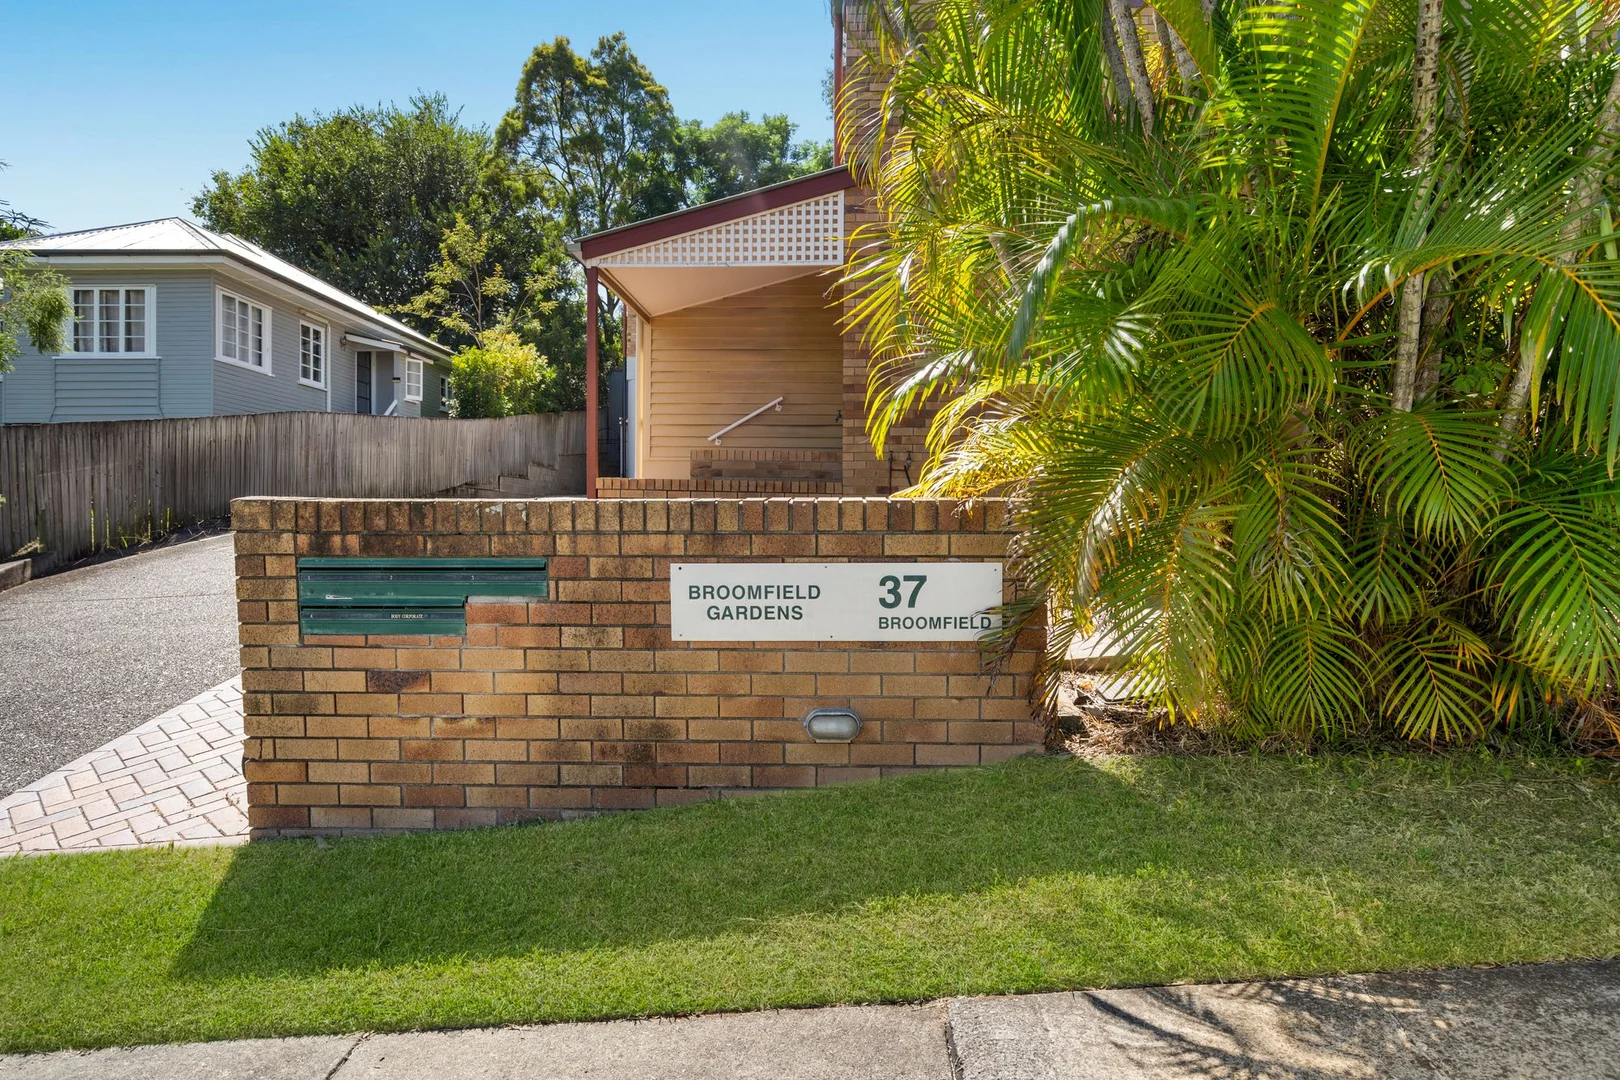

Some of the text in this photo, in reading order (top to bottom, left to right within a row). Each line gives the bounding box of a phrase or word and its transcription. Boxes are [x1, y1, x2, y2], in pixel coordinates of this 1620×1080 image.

[688, 585, 821, 601] BROOMFIELD
[878, 575, 928, 610] 37
[706, 605, 804, 621] GARDENS
[878, 616, 992, 630] BROOMFIELD
